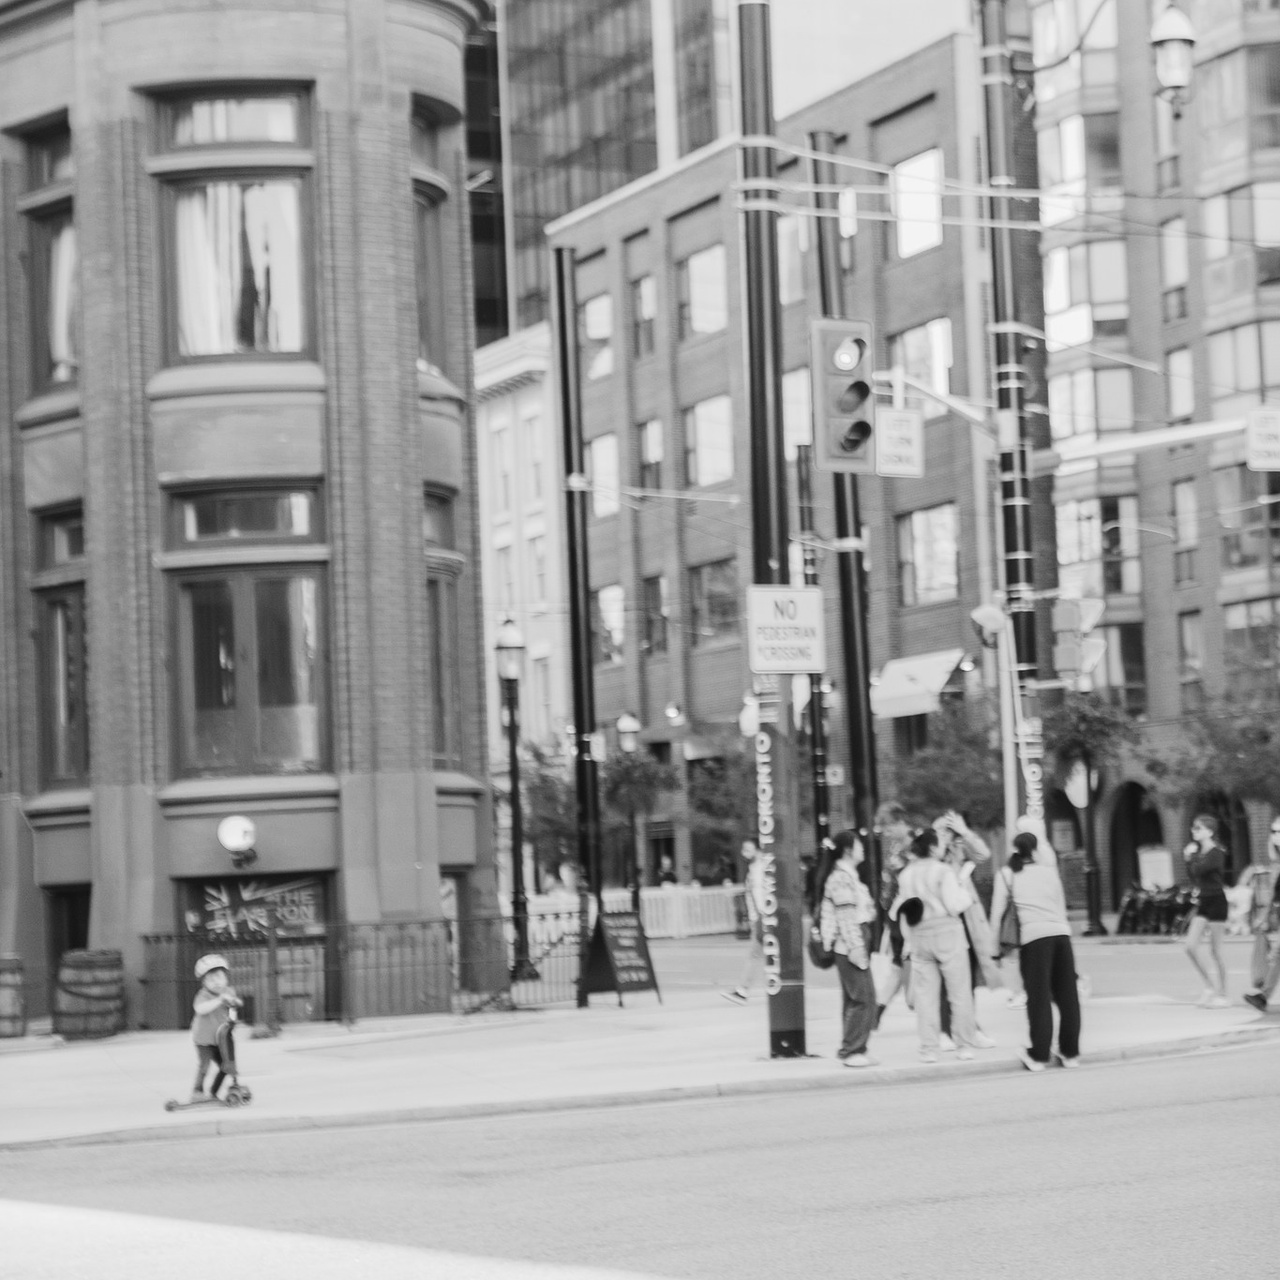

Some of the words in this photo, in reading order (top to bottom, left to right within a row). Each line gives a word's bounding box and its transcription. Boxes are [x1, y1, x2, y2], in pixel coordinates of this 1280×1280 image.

[773, 599, 798, 621] NO
[756, 625, 818, 641] PEDESTRIAN
[761, 646, 813, 662] CROSSING
[755, 731, 775, 849] TORONTO
[762, 933, 782, 996] OLD
